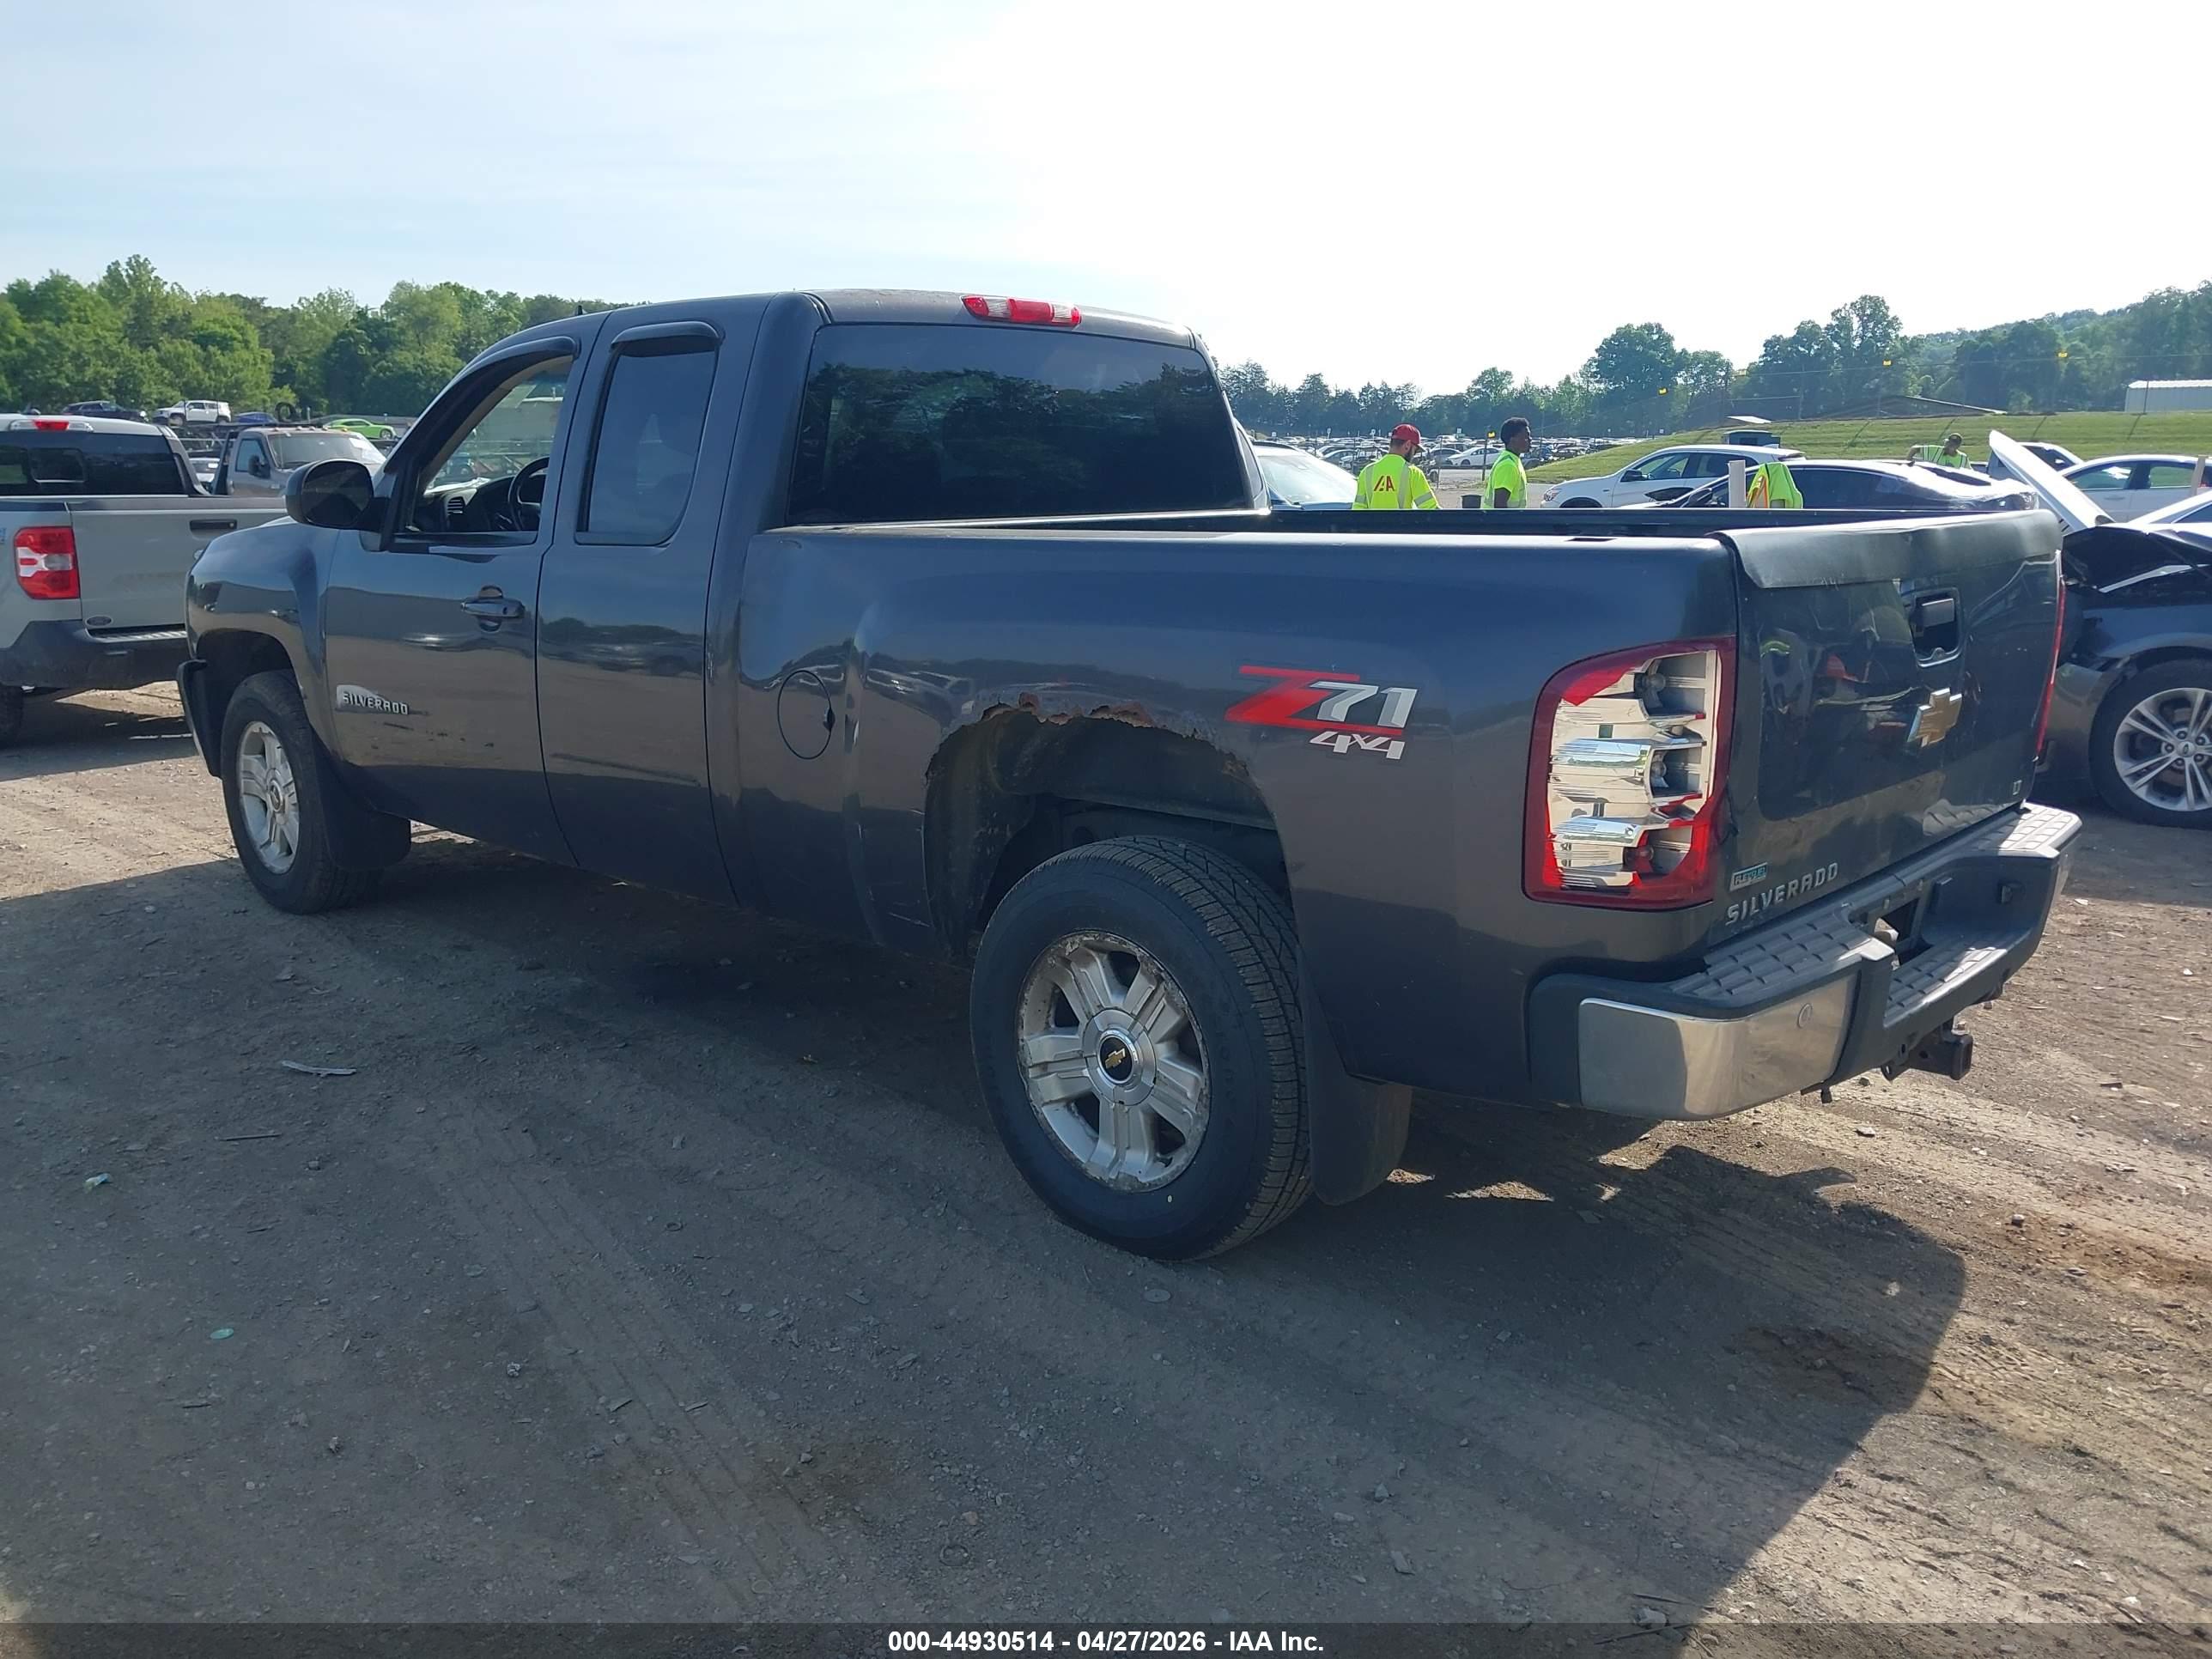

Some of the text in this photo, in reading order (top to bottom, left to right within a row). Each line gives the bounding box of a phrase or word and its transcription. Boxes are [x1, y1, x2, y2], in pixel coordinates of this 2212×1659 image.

[343, 692, 409, 715] SILVERADO
[1224, 665, 1418, 736] Z71
[1725, 861, 1838, 926] SILVERADO
